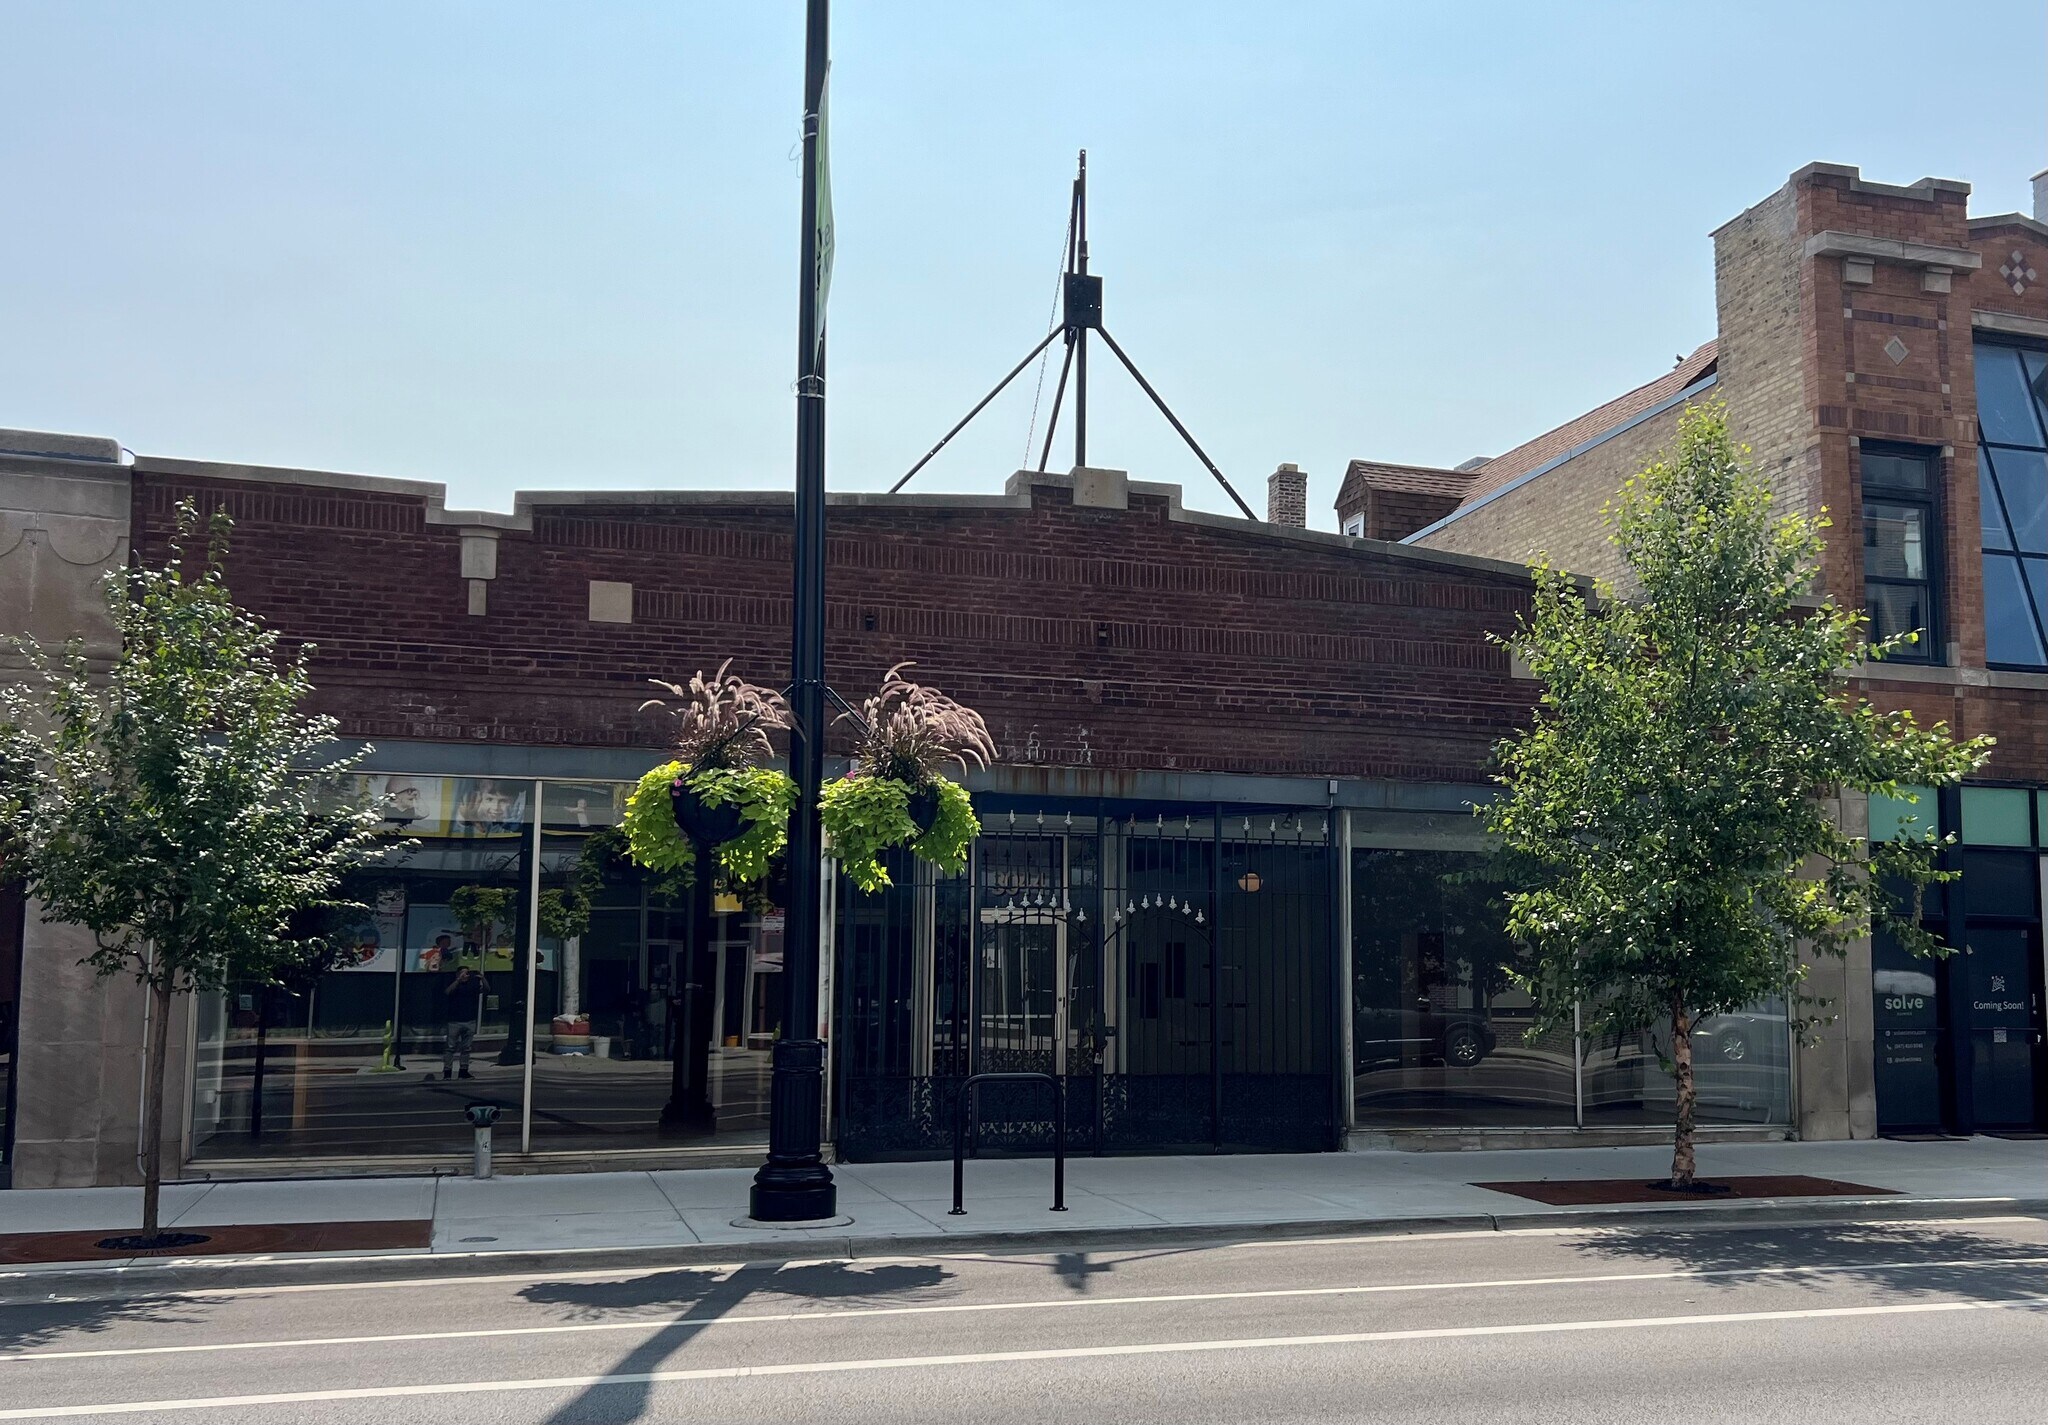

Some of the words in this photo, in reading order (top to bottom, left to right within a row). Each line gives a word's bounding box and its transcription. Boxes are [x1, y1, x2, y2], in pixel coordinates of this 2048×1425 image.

[1885, 994, 1924, 1010] solve
[1973, 1001, 2002, 1012] Coming
[2003, 1001, 2025, 1011] Soon!
